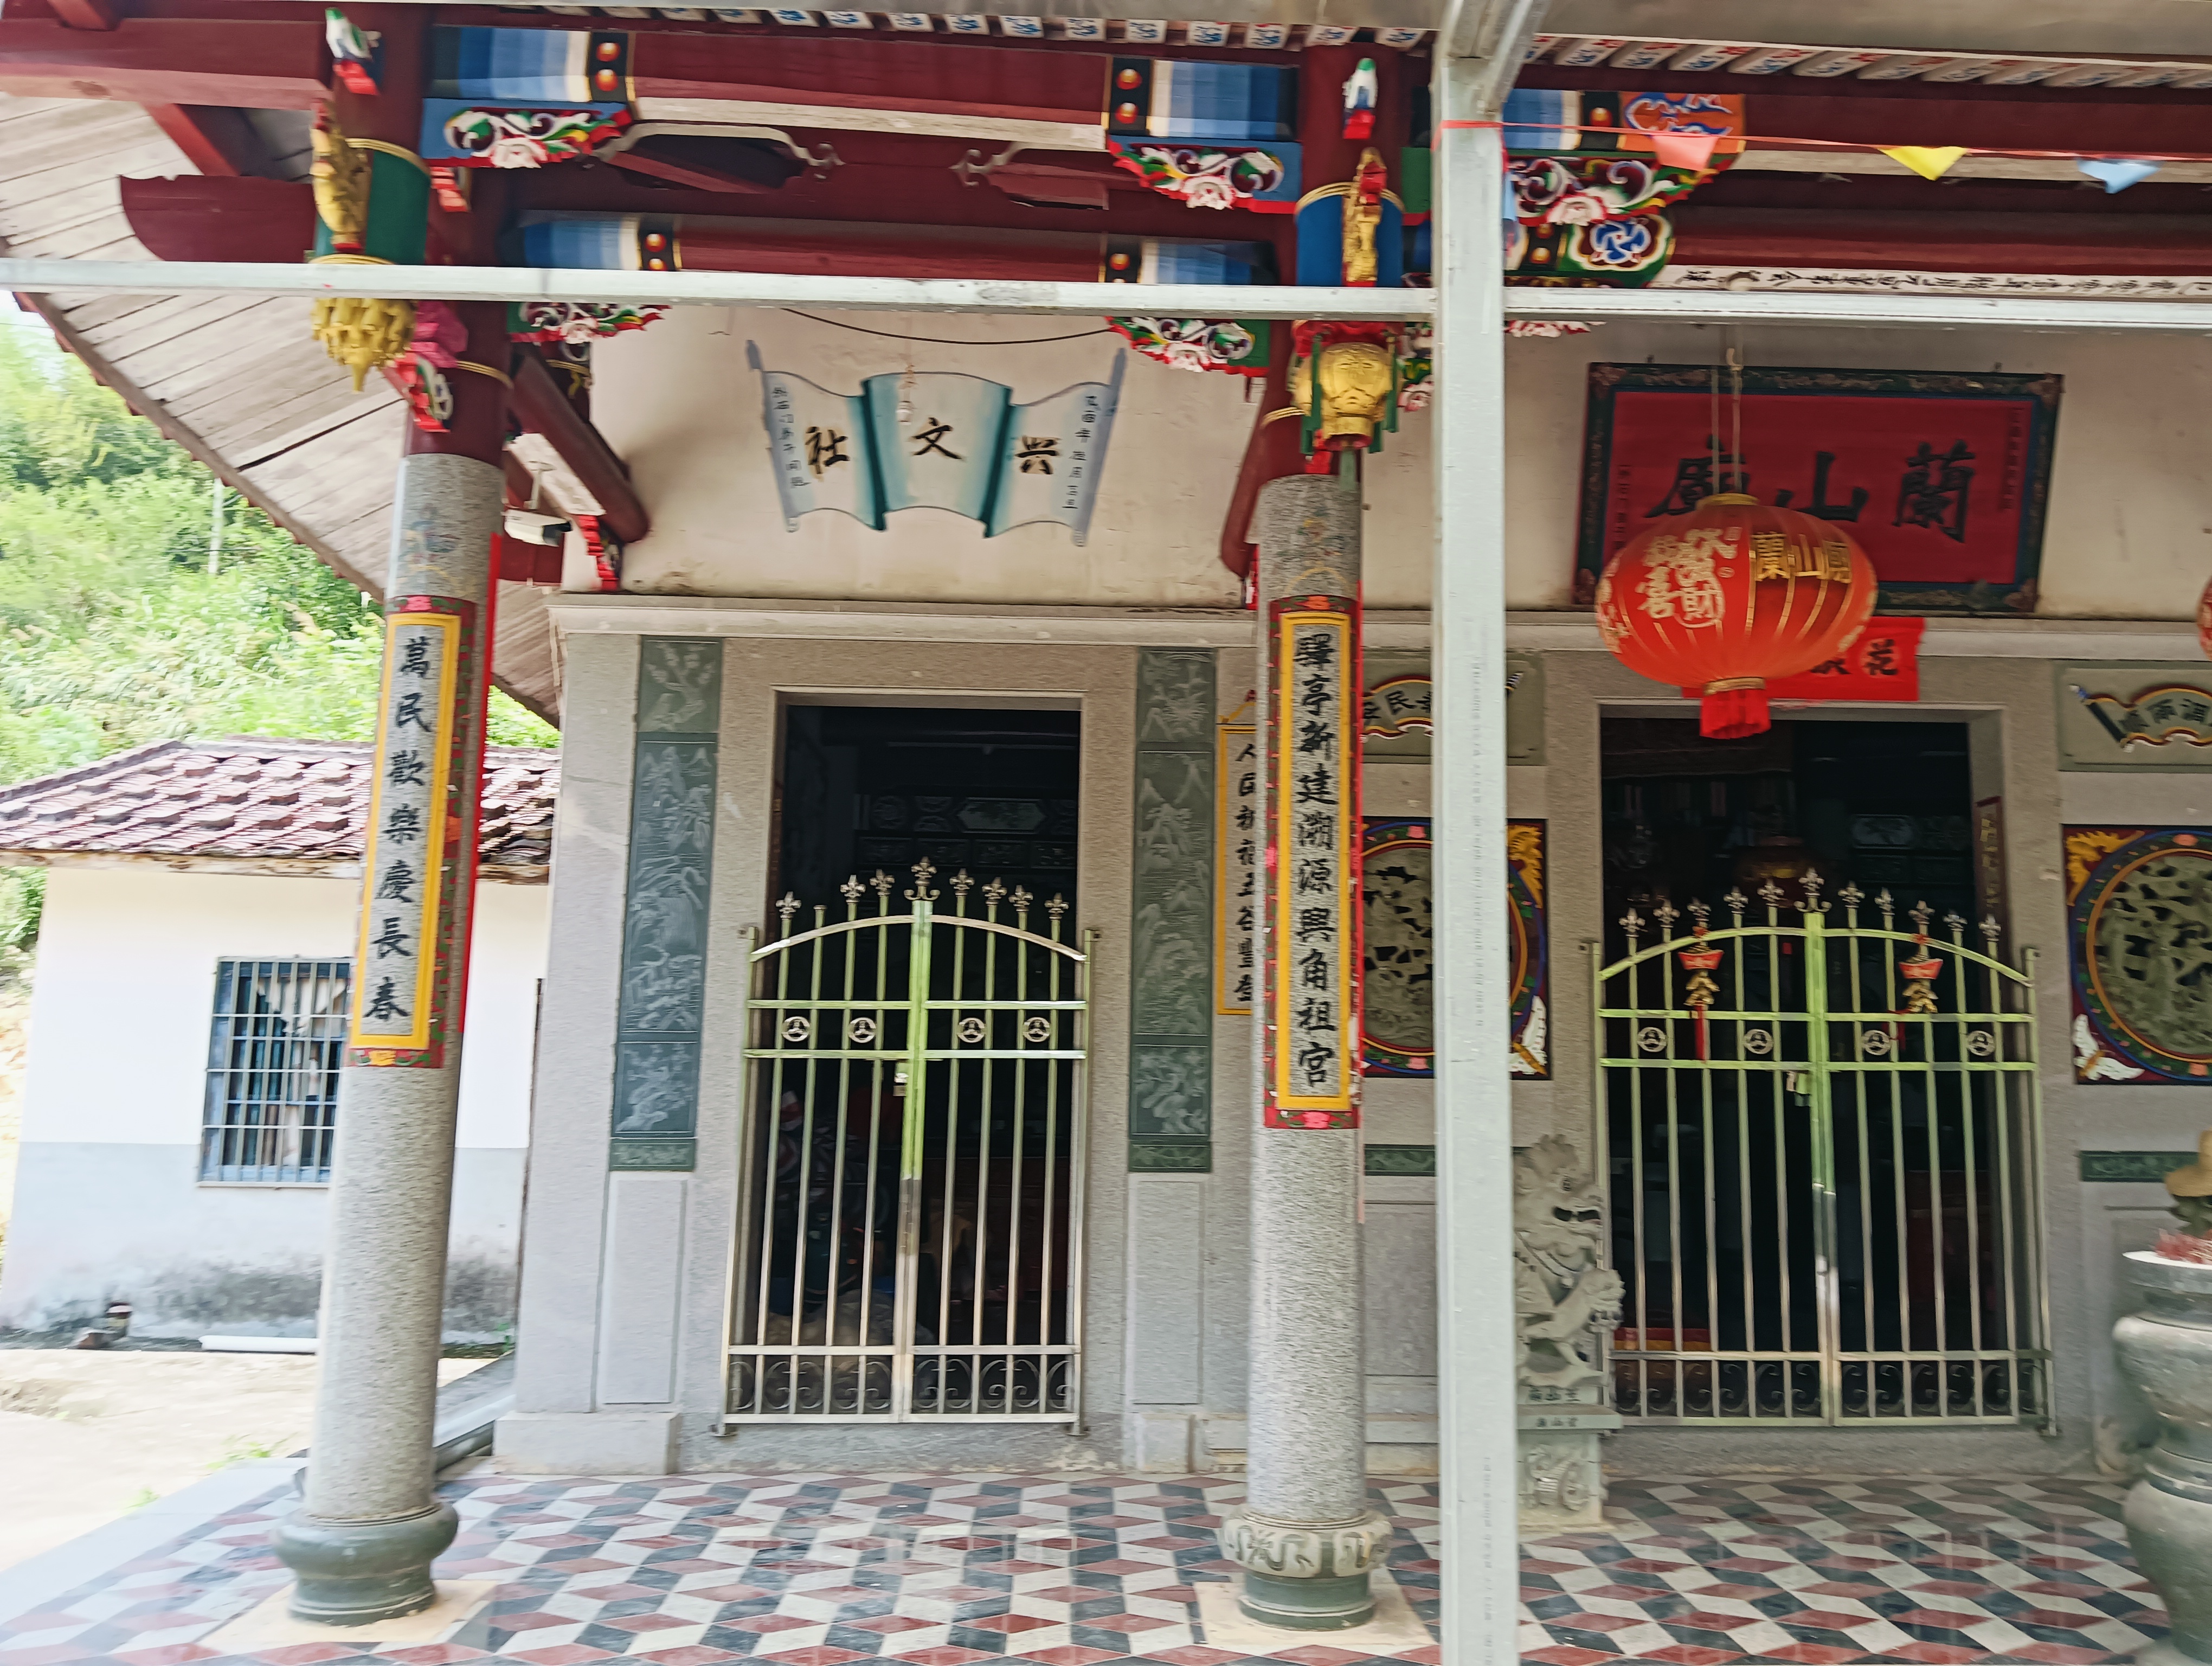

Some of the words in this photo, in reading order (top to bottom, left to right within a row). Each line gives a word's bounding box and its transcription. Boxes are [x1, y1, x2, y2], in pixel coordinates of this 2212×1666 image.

[363, 636, 433, 1022] 萬民歡樂慶長春
